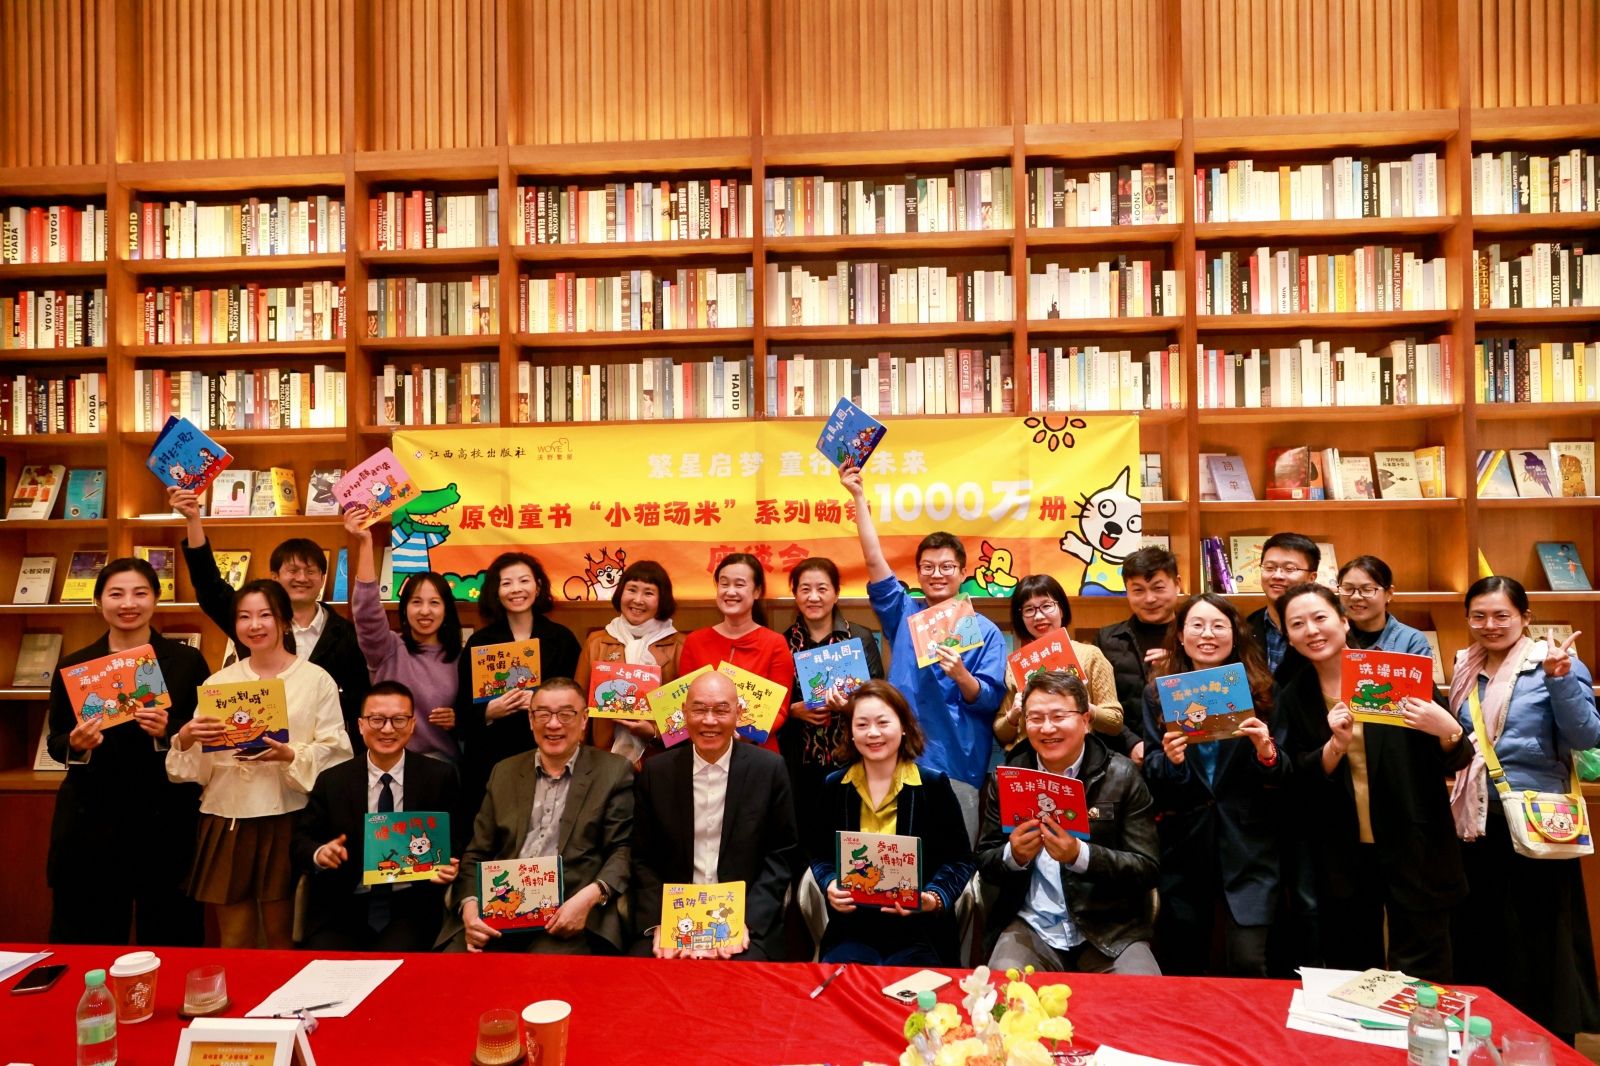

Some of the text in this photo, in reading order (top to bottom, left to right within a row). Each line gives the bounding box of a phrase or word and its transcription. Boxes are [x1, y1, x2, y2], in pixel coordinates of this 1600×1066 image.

[1134, 191, 1142, 222] KOONS
[129, 212, 138, 250] HADID
[45, 297, 53, 331] POADA
[732, 373, 740, 412] HADID
[88, 394, 96, 428] POADA
[210, 418, 216, 427] LO
[429, 446, 527, 461] 江西高校出版社
[537, 445, 563, 454] WOYE
[779, 450, 932, 477] 童行未来
[813, 644, 862, 664] 我是小园丁
[1019, 641, 1063, 669] 洗澡时间
[616, 667, 651, 682] 上台演出
[1359, 663, 1423, 684] 洗澡时间
[1009, 778, 1076, 796] 汤米当医生
[877, 840, 899, 854] 参观
[880, 853, 916, 868] 博物馆
[518, 863, 540, 878] 参观
[521, 871, 557, 887] 博物馆
[673, 891, 735, 910] 西饼屋的一天
